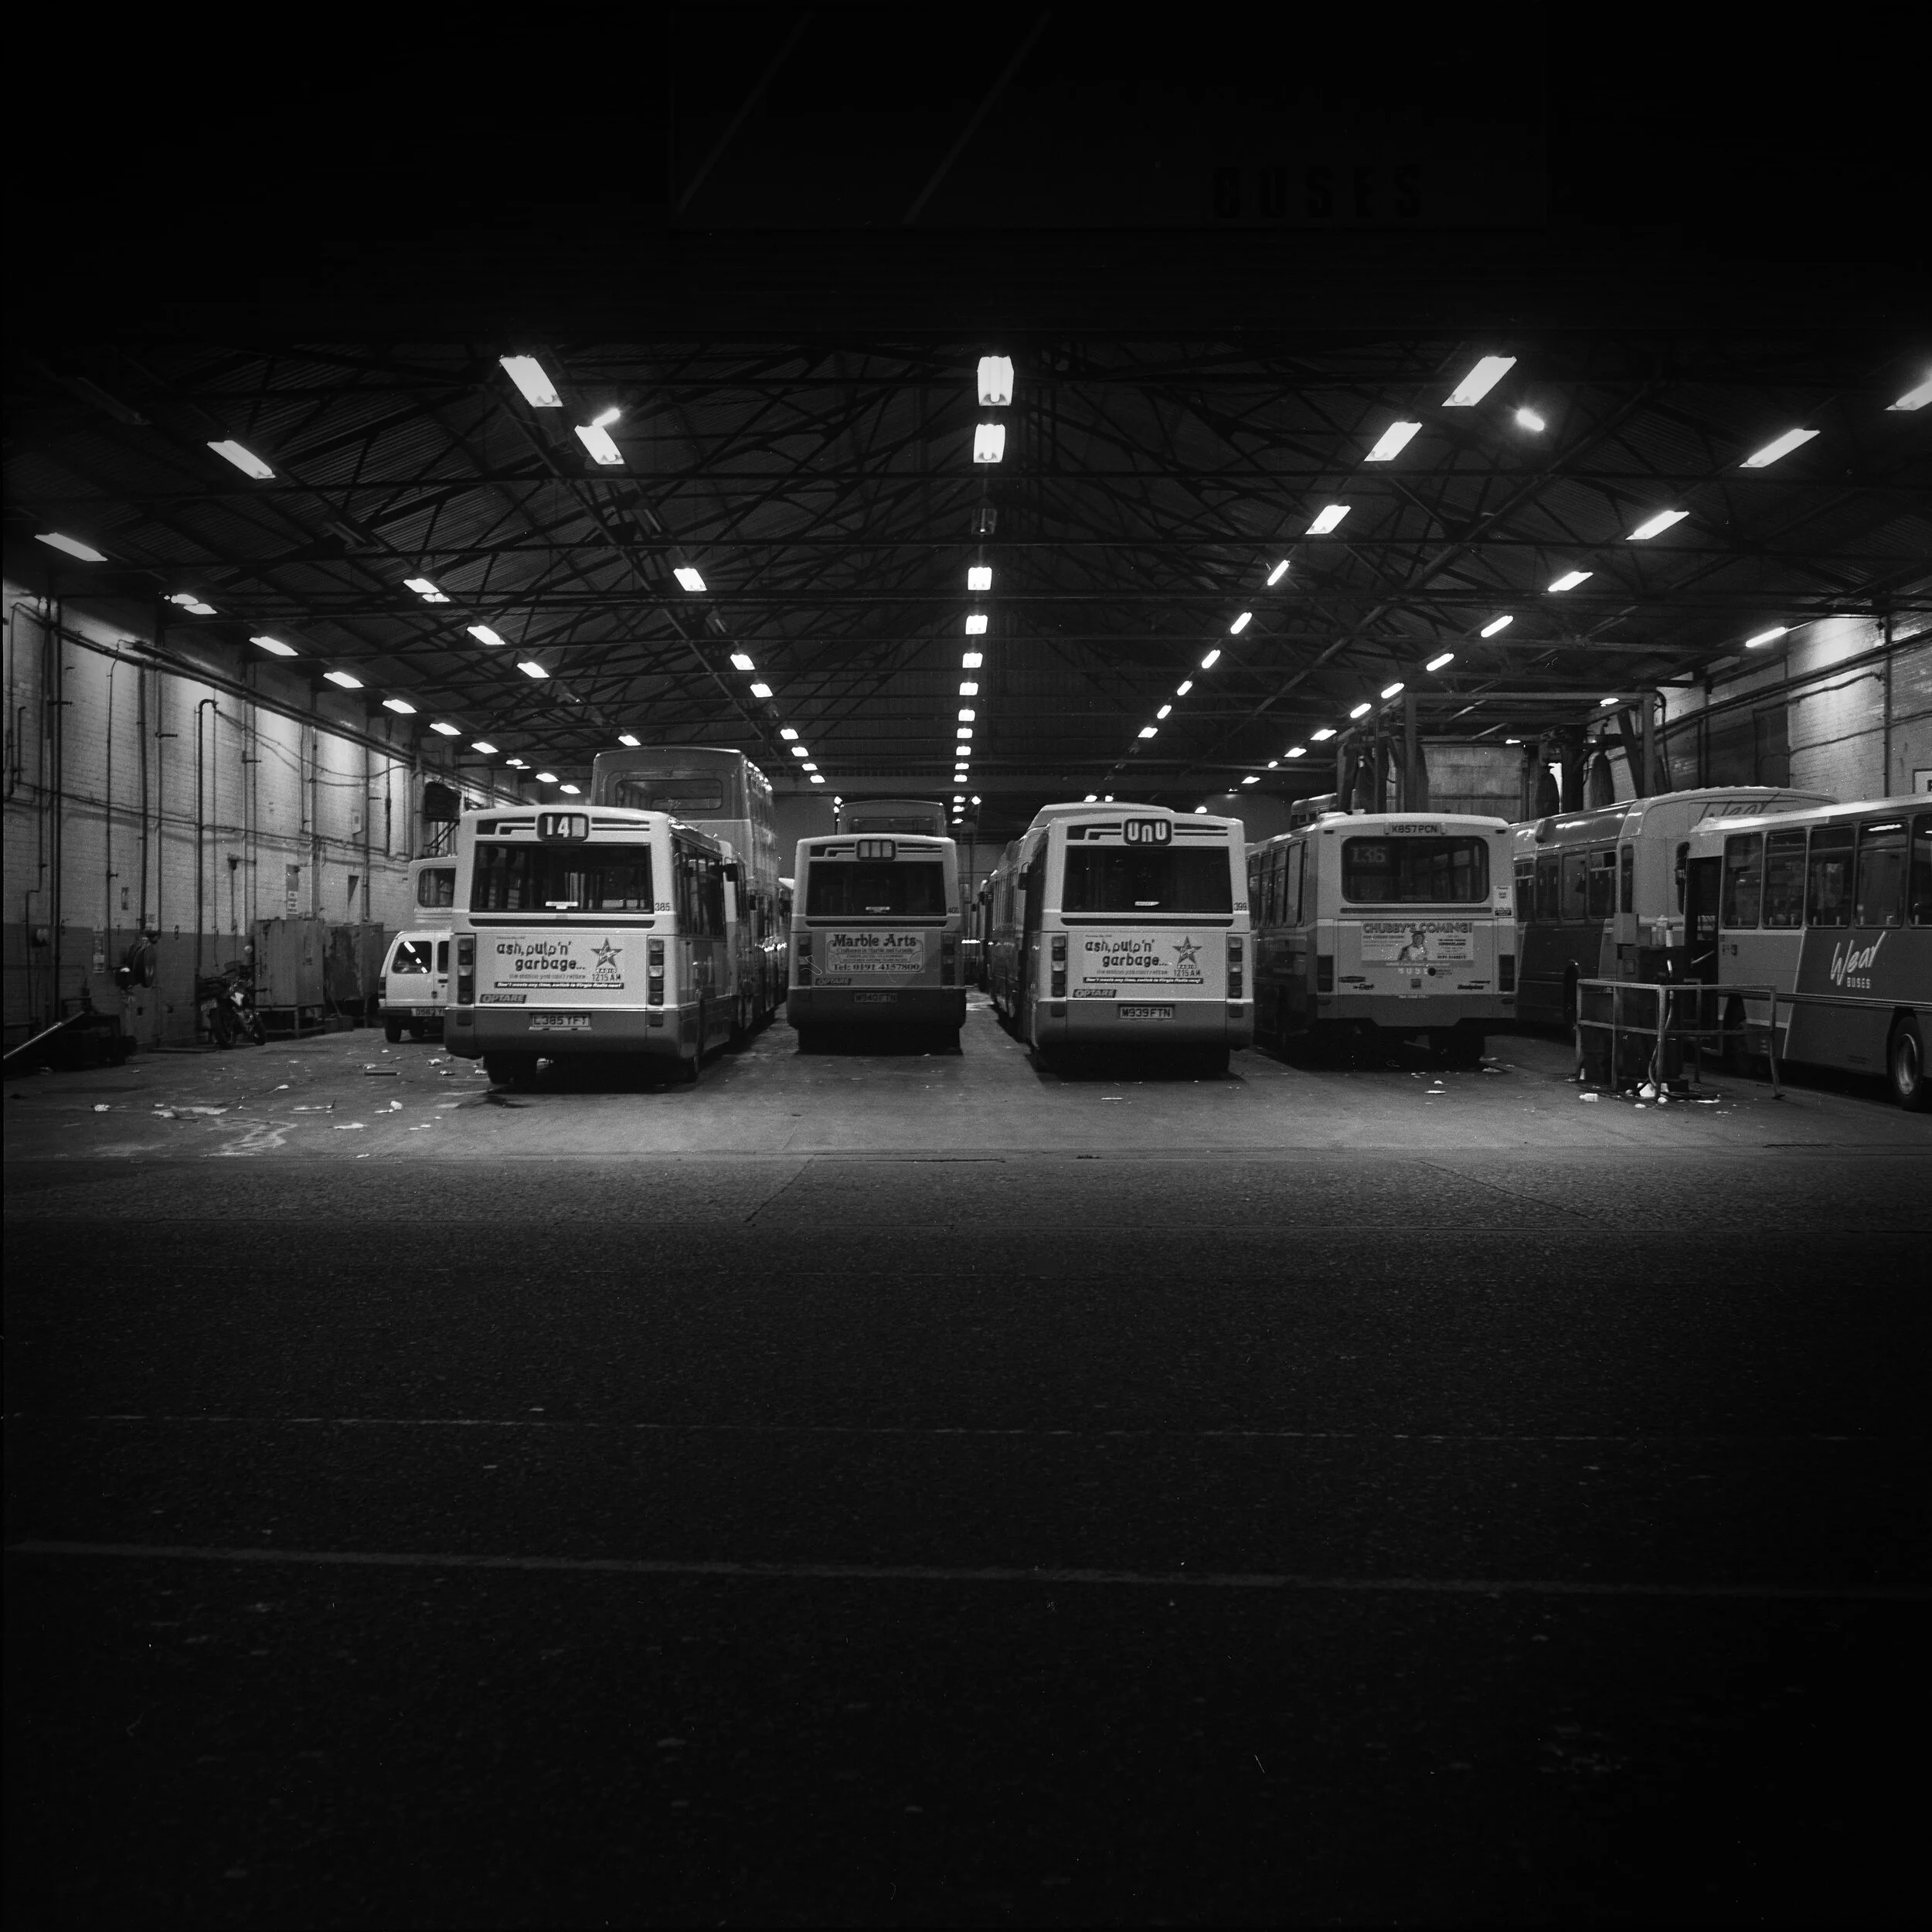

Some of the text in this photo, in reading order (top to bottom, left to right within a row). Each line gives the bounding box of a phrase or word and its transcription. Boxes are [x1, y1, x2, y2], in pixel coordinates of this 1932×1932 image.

[1213, 165, 1421, 219] BUSES
[655, 903, 670, 912] 385
[1419, 922, 1473, 934] COMING!
[832, 933, 917, 947] Marble Arts
[1830, 930, 1886, 987] Wear
[1847, 977, 1871, 989] BUSES
[481, 995, 526, 1003] OPTARE
[1121, 1008, 1171, 1018] M939FTN
